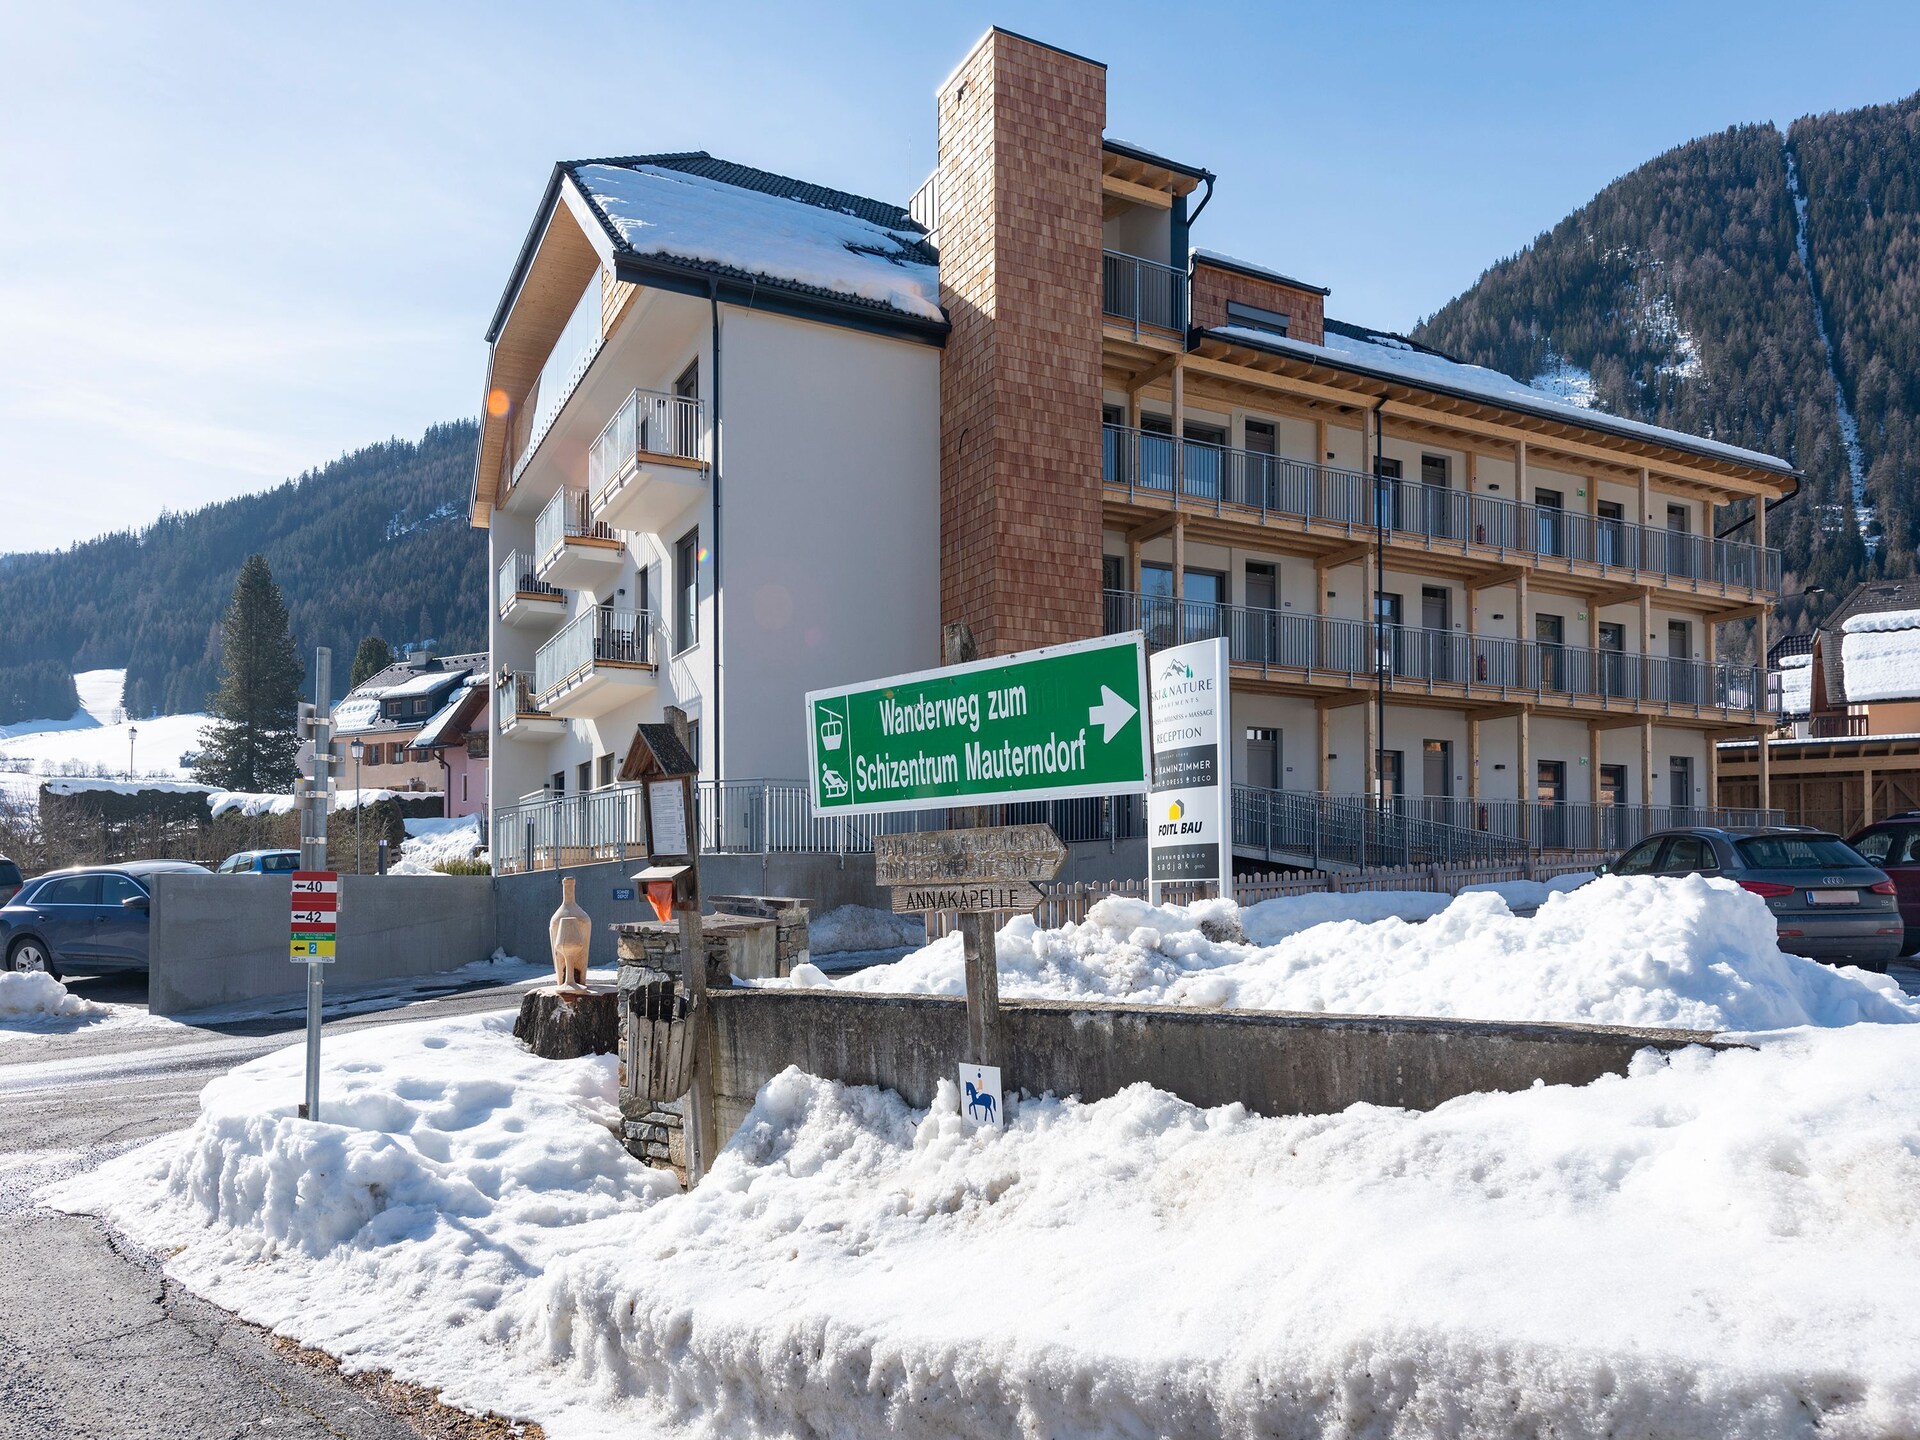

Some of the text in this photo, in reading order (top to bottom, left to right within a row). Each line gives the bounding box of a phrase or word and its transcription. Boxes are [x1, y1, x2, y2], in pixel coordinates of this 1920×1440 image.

[879, 685, 1027, 733] Wanderweg zum
[1188, 708, 1213, 718] MASSAGE
[1157, 726, 1202, 744] RECEPTION
[856, 728, 1086, 792] Schizentrum Mauterndorf
[1159, 760, 1211, 775] KAMINZIMMER
[1192, 774, 1211, 783] DECO
[1158, 821, 1203, 836] FOITL BAU
[1157, 861, 1190, 872] sadjak
[306, 880, 323, 893] 40
[906, 889, 1020, 910] ANNAKAPELLE
[305, 911, 321, 923] 42
[310, 944, 316, 953] 2
